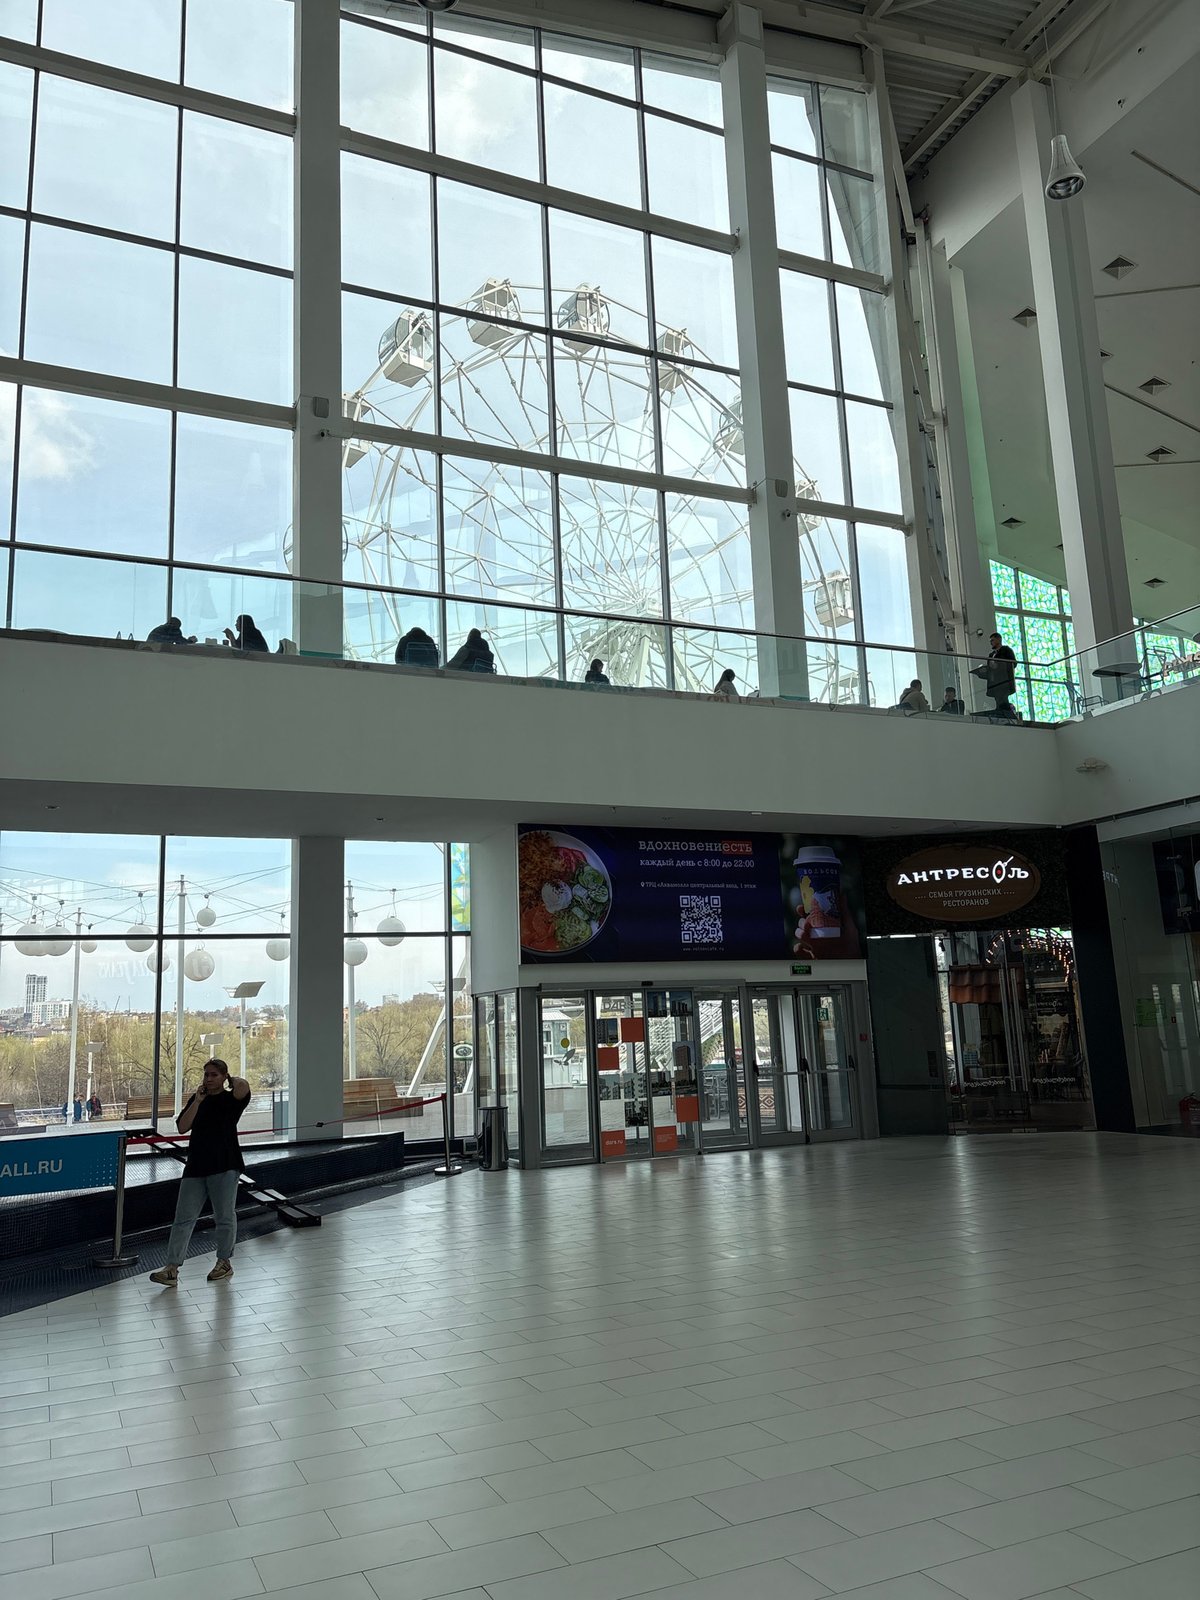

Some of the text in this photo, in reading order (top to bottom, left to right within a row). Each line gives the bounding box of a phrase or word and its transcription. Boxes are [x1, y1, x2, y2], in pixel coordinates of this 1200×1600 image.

[638, 840, 752, 853] вдохновениесть
[640, 859, 674, 868] каждый
[676, 860, 696, 868] день
[704, 859, 720, 867] 8:00
[722, 861, 732, 869] до
[734, 860, 754, 868] 22:00
[897, 857, 1030, 886] АНТРЕСОЛЬ
[928, 889, 1002, 899] СЕМЬЯ ГРУЗИНСКИХ
[943, 899, 990, 907] РЕСТОРАНОВ
[0, 1159, 63, 1179] ALL.RU
